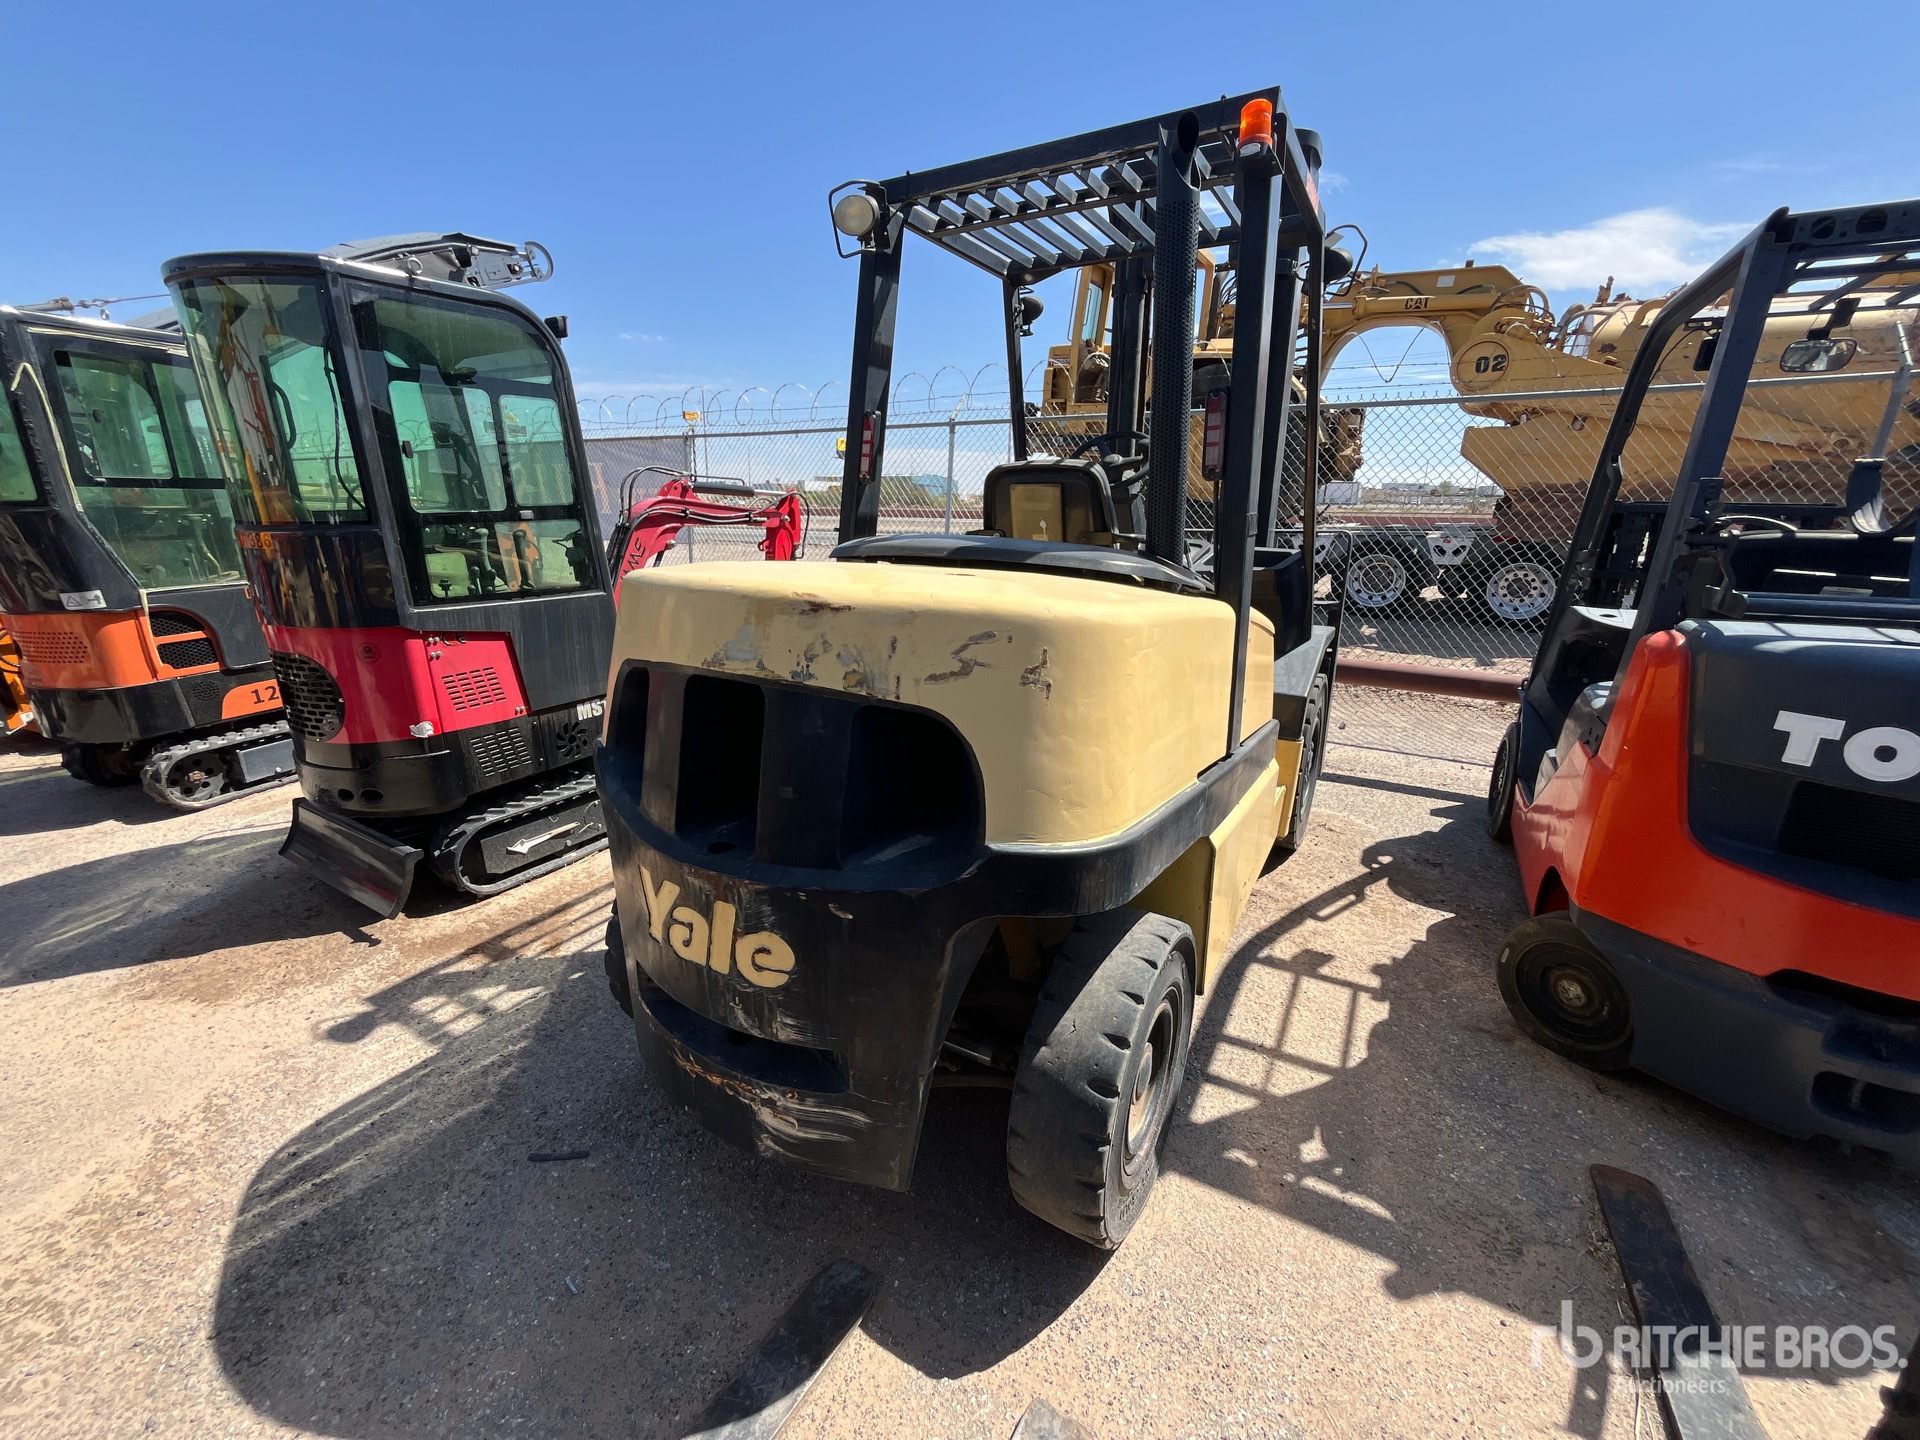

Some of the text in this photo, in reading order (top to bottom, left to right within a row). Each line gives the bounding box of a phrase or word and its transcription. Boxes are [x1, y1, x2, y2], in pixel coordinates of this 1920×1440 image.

[1405, 297, 1430, 310] CAT
[1475, 354, 1507, 374] 02
[251, 685, 280, 704] 12
[1773, 710, 1920, 782] TO
[638, 864, 796, 988] Yale
